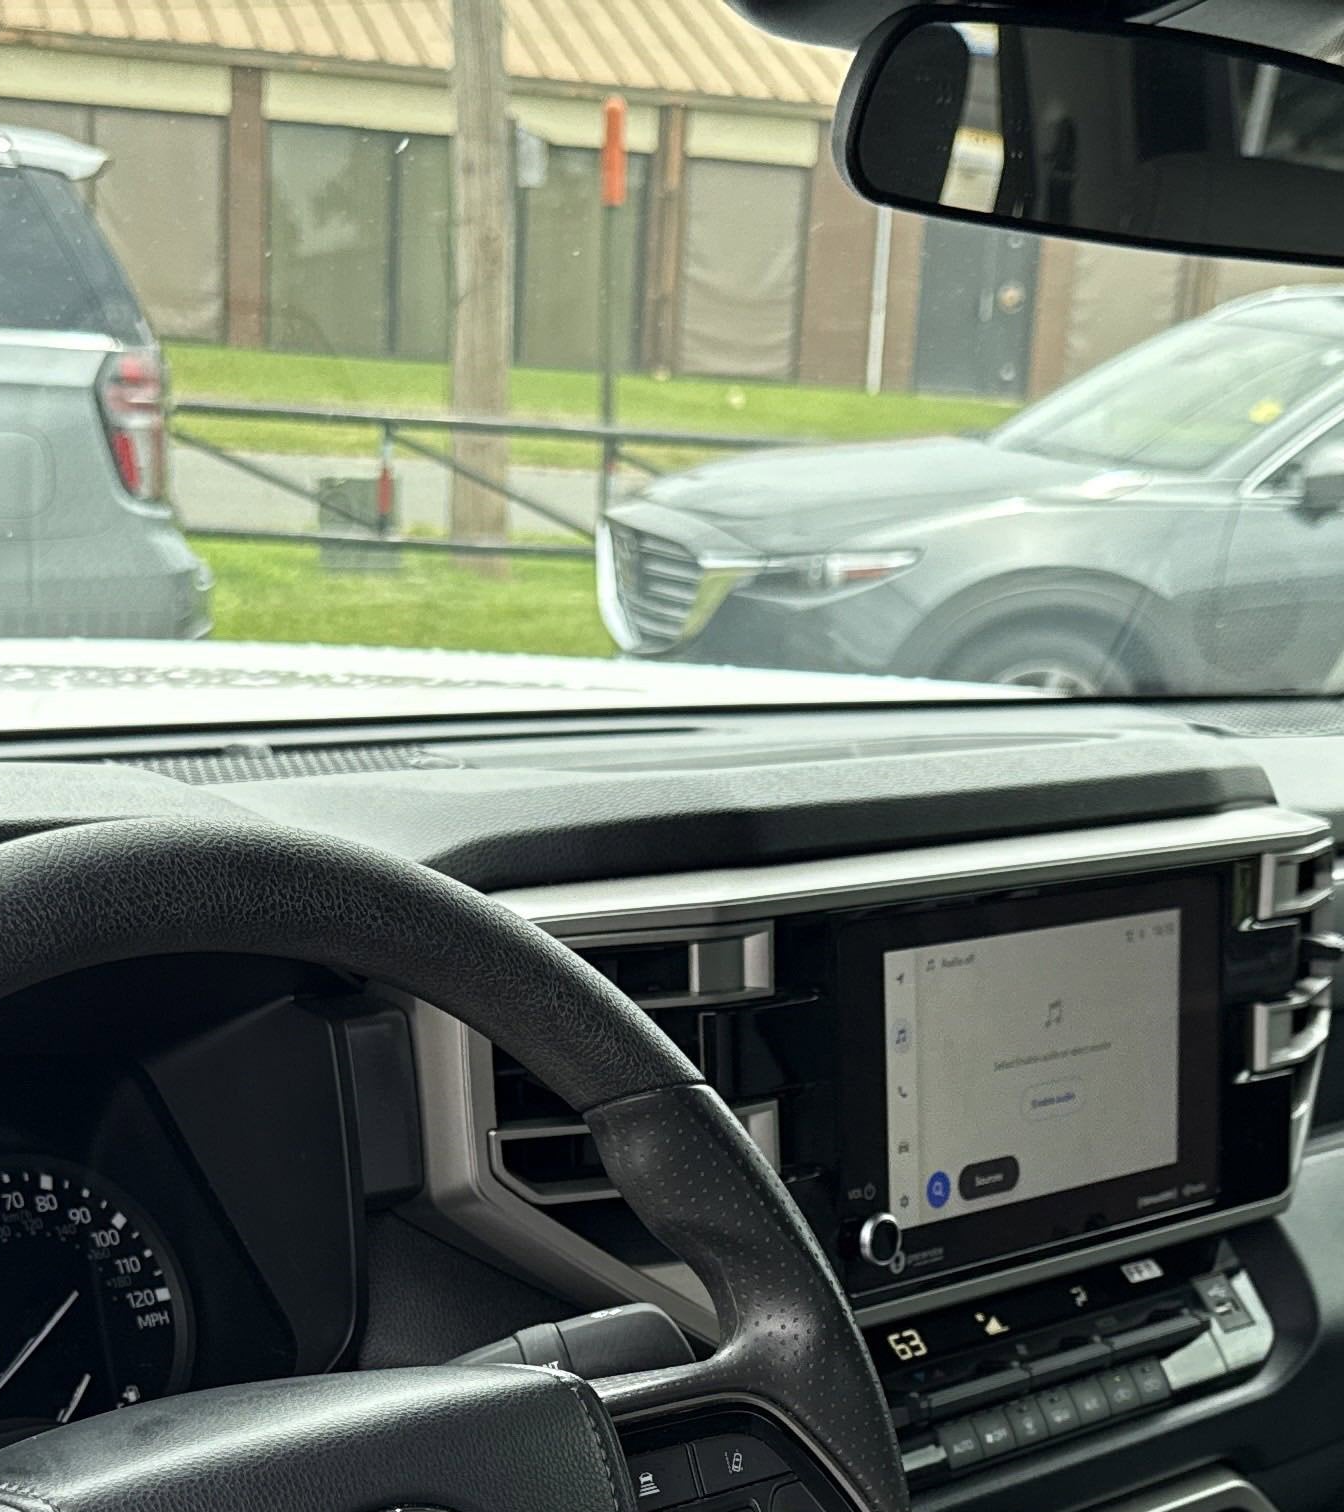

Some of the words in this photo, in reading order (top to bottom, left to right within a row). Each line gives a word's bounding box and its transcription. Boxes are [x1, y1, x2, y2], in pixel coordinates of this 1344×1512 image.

[1, 1191, 25, 1211] 70
[35, 1193, 58, 1213] 80
[68, 1207, 92, 1225] 90
[90, 1230, 120, 1248] 100
[115, 1256, 141, 1275] 110
[126, 1289, 156, 1309] 120
[137, 1311, 170, 1330] MPH
[888, 1329, 928, 1361] 63
